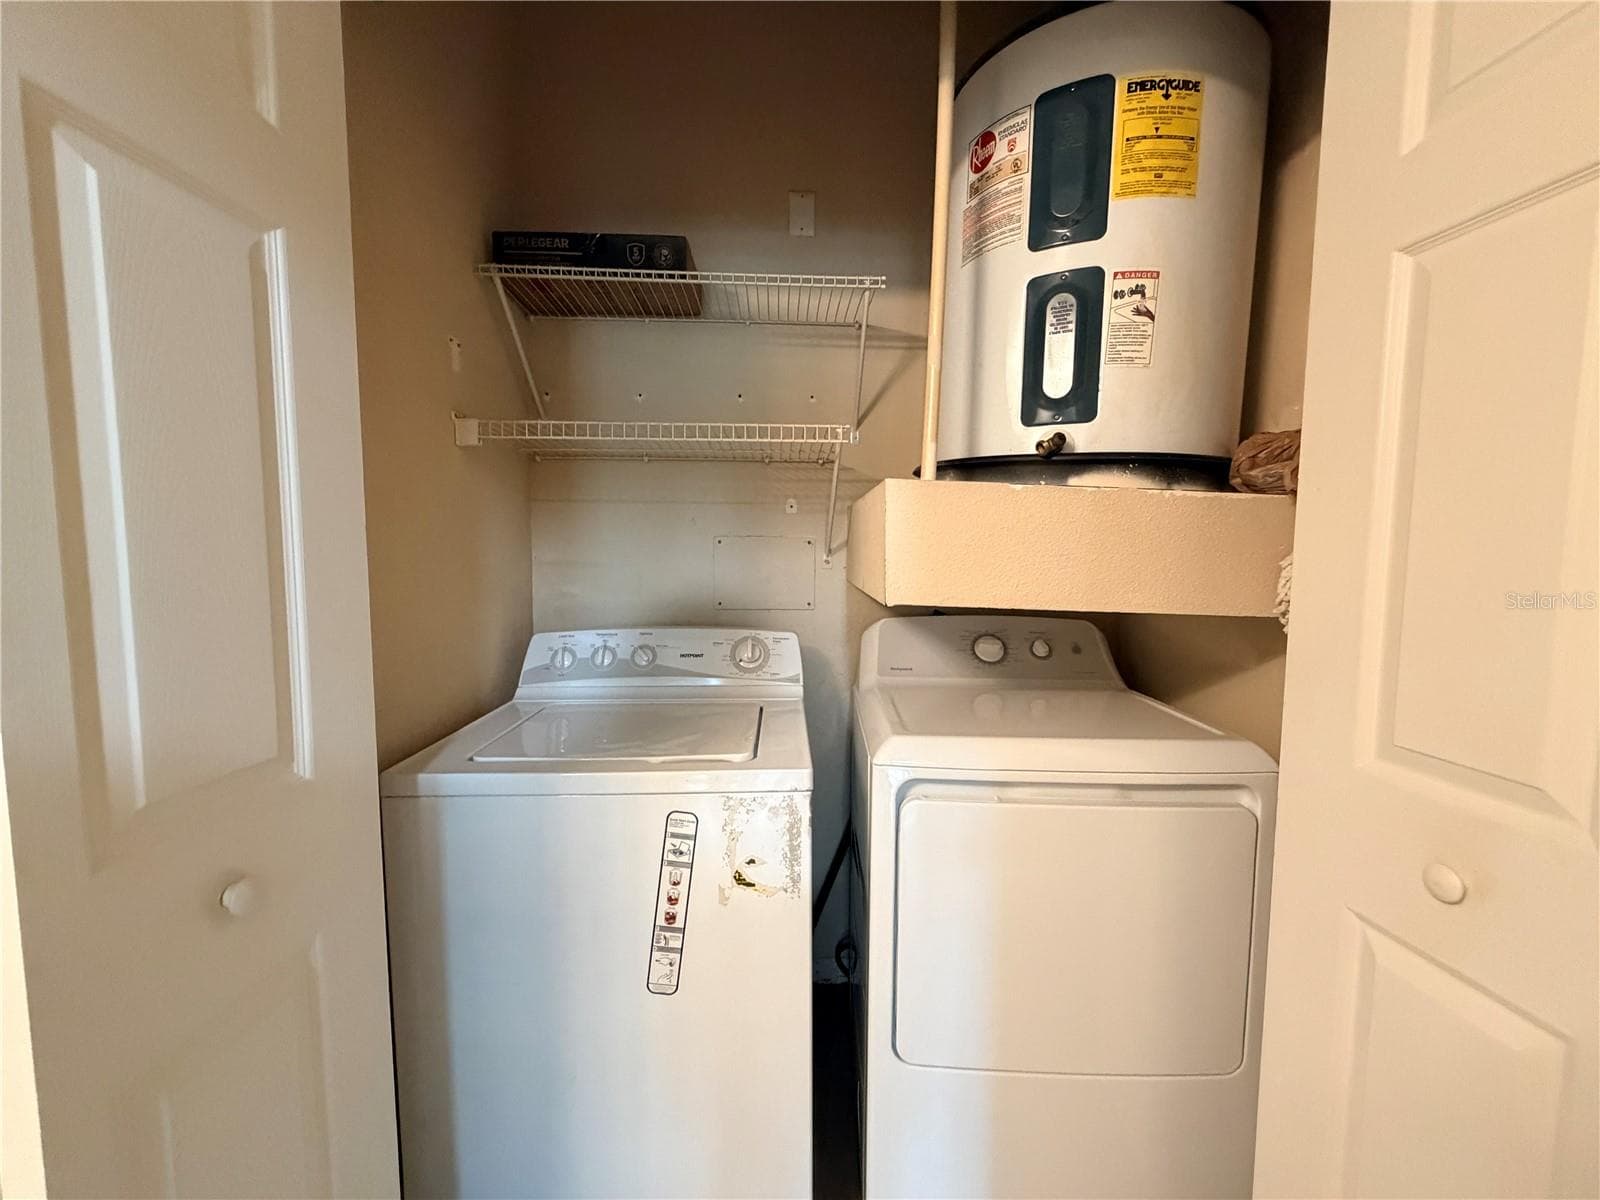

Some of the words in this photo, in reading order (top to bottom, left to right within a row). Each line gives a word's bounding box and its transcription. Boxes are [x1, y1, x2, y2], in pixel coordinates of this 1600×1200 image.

[999, 125, 1027, 142] STANDARD
[972, 137, 996, 173] Rheem
[1124, 271, 1158, 279] DANGER
